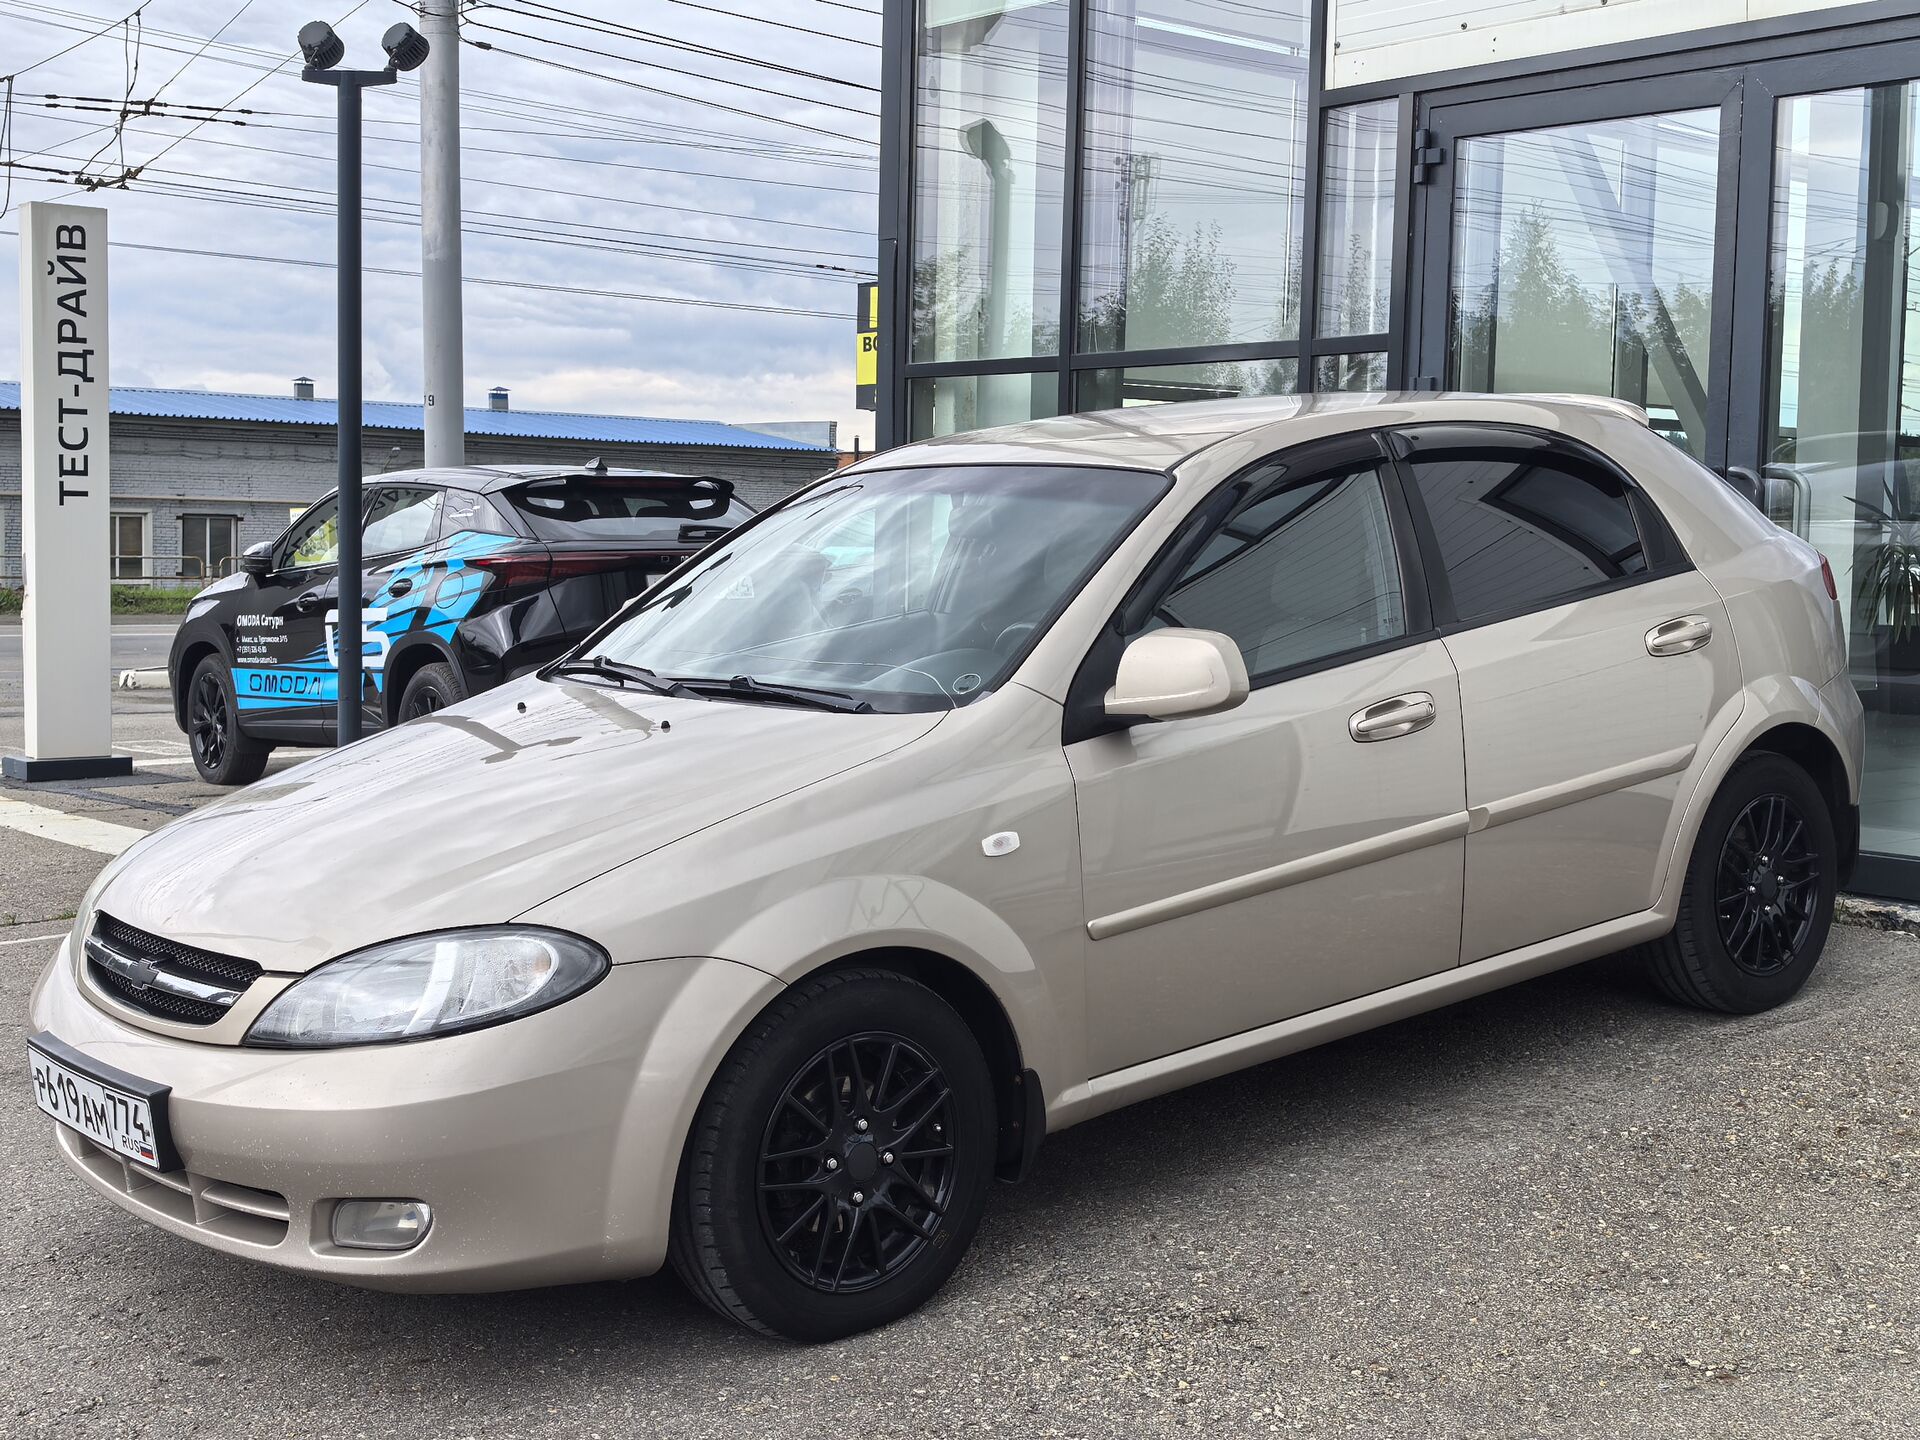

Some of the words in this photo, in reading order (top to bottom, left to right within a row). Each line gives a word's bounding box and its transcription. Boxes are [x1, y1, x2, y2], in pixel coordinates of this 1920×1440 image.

[47, 224, 95, 506] ТЕСТ-ДРАЙВ
[236, 614, 260, 627] OMODA
[249, 673, 321, 695] OMODA
[121, 1134, 141, 1154] RUS
